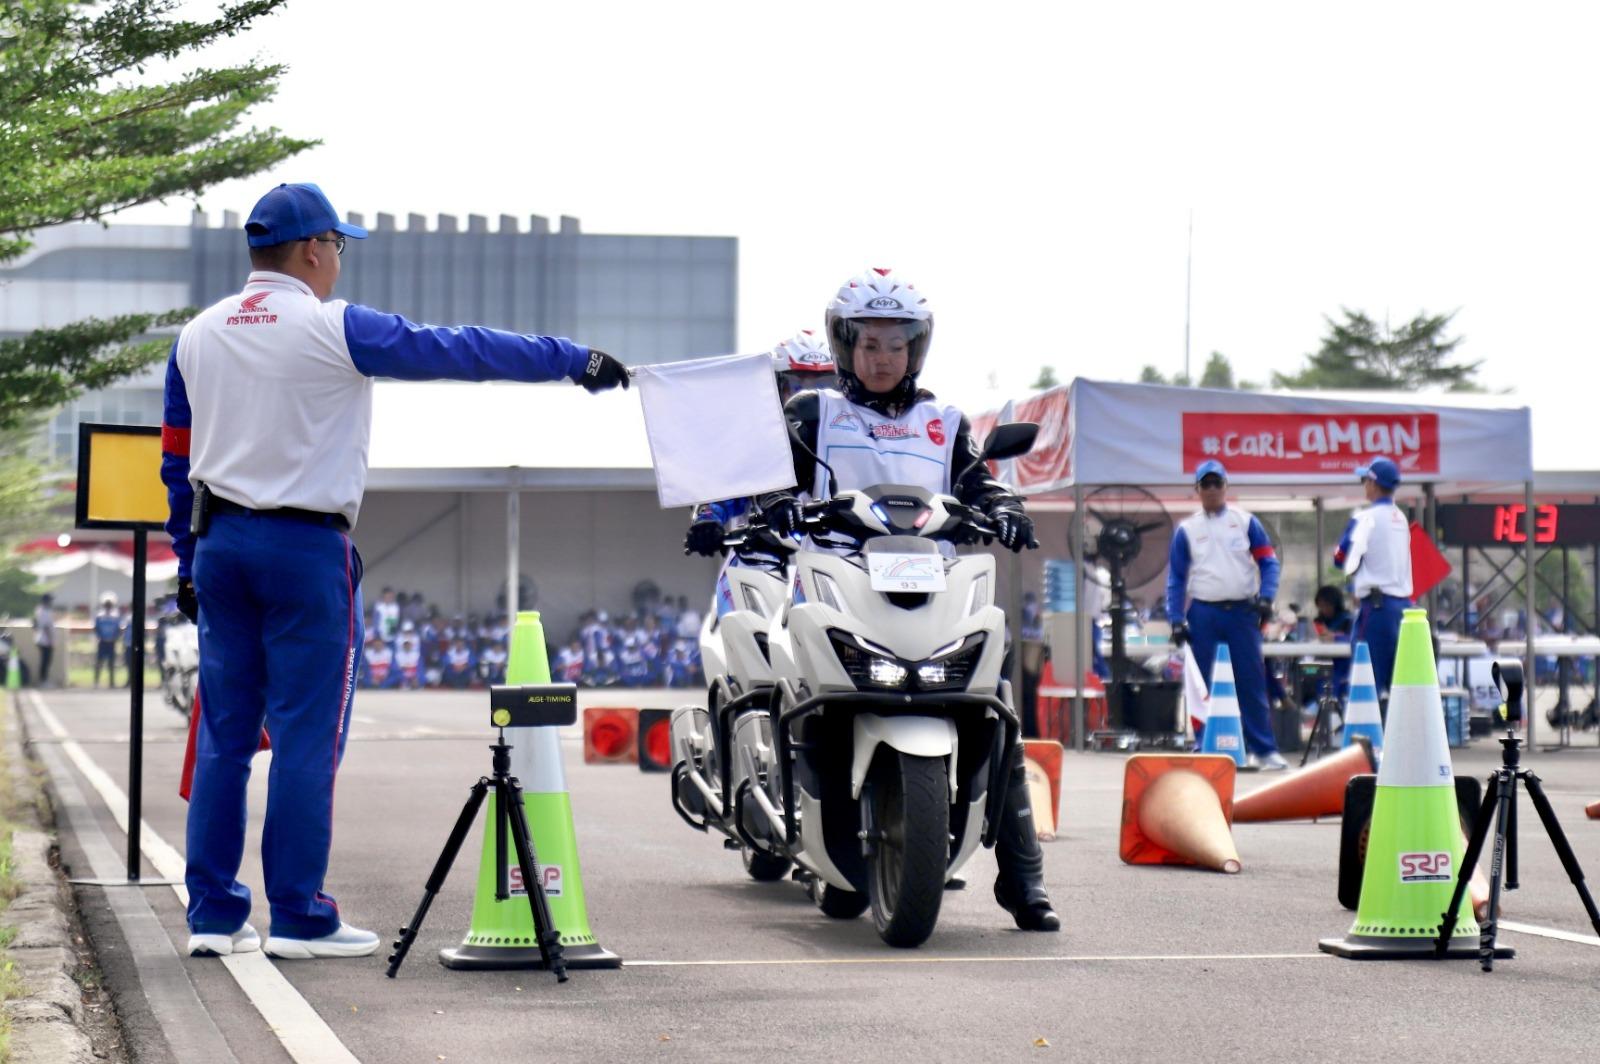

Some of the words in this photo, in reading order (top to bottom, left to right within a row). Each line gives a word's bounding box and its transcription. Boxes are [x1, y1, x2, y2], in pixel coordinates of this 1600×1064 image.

[226, 315, 278, 325] INSTRUKTUR
[900, 582, 918, 590] 93
[1401, 853, 1450, 876] SRP
[510, 867, 561, 889] SP
